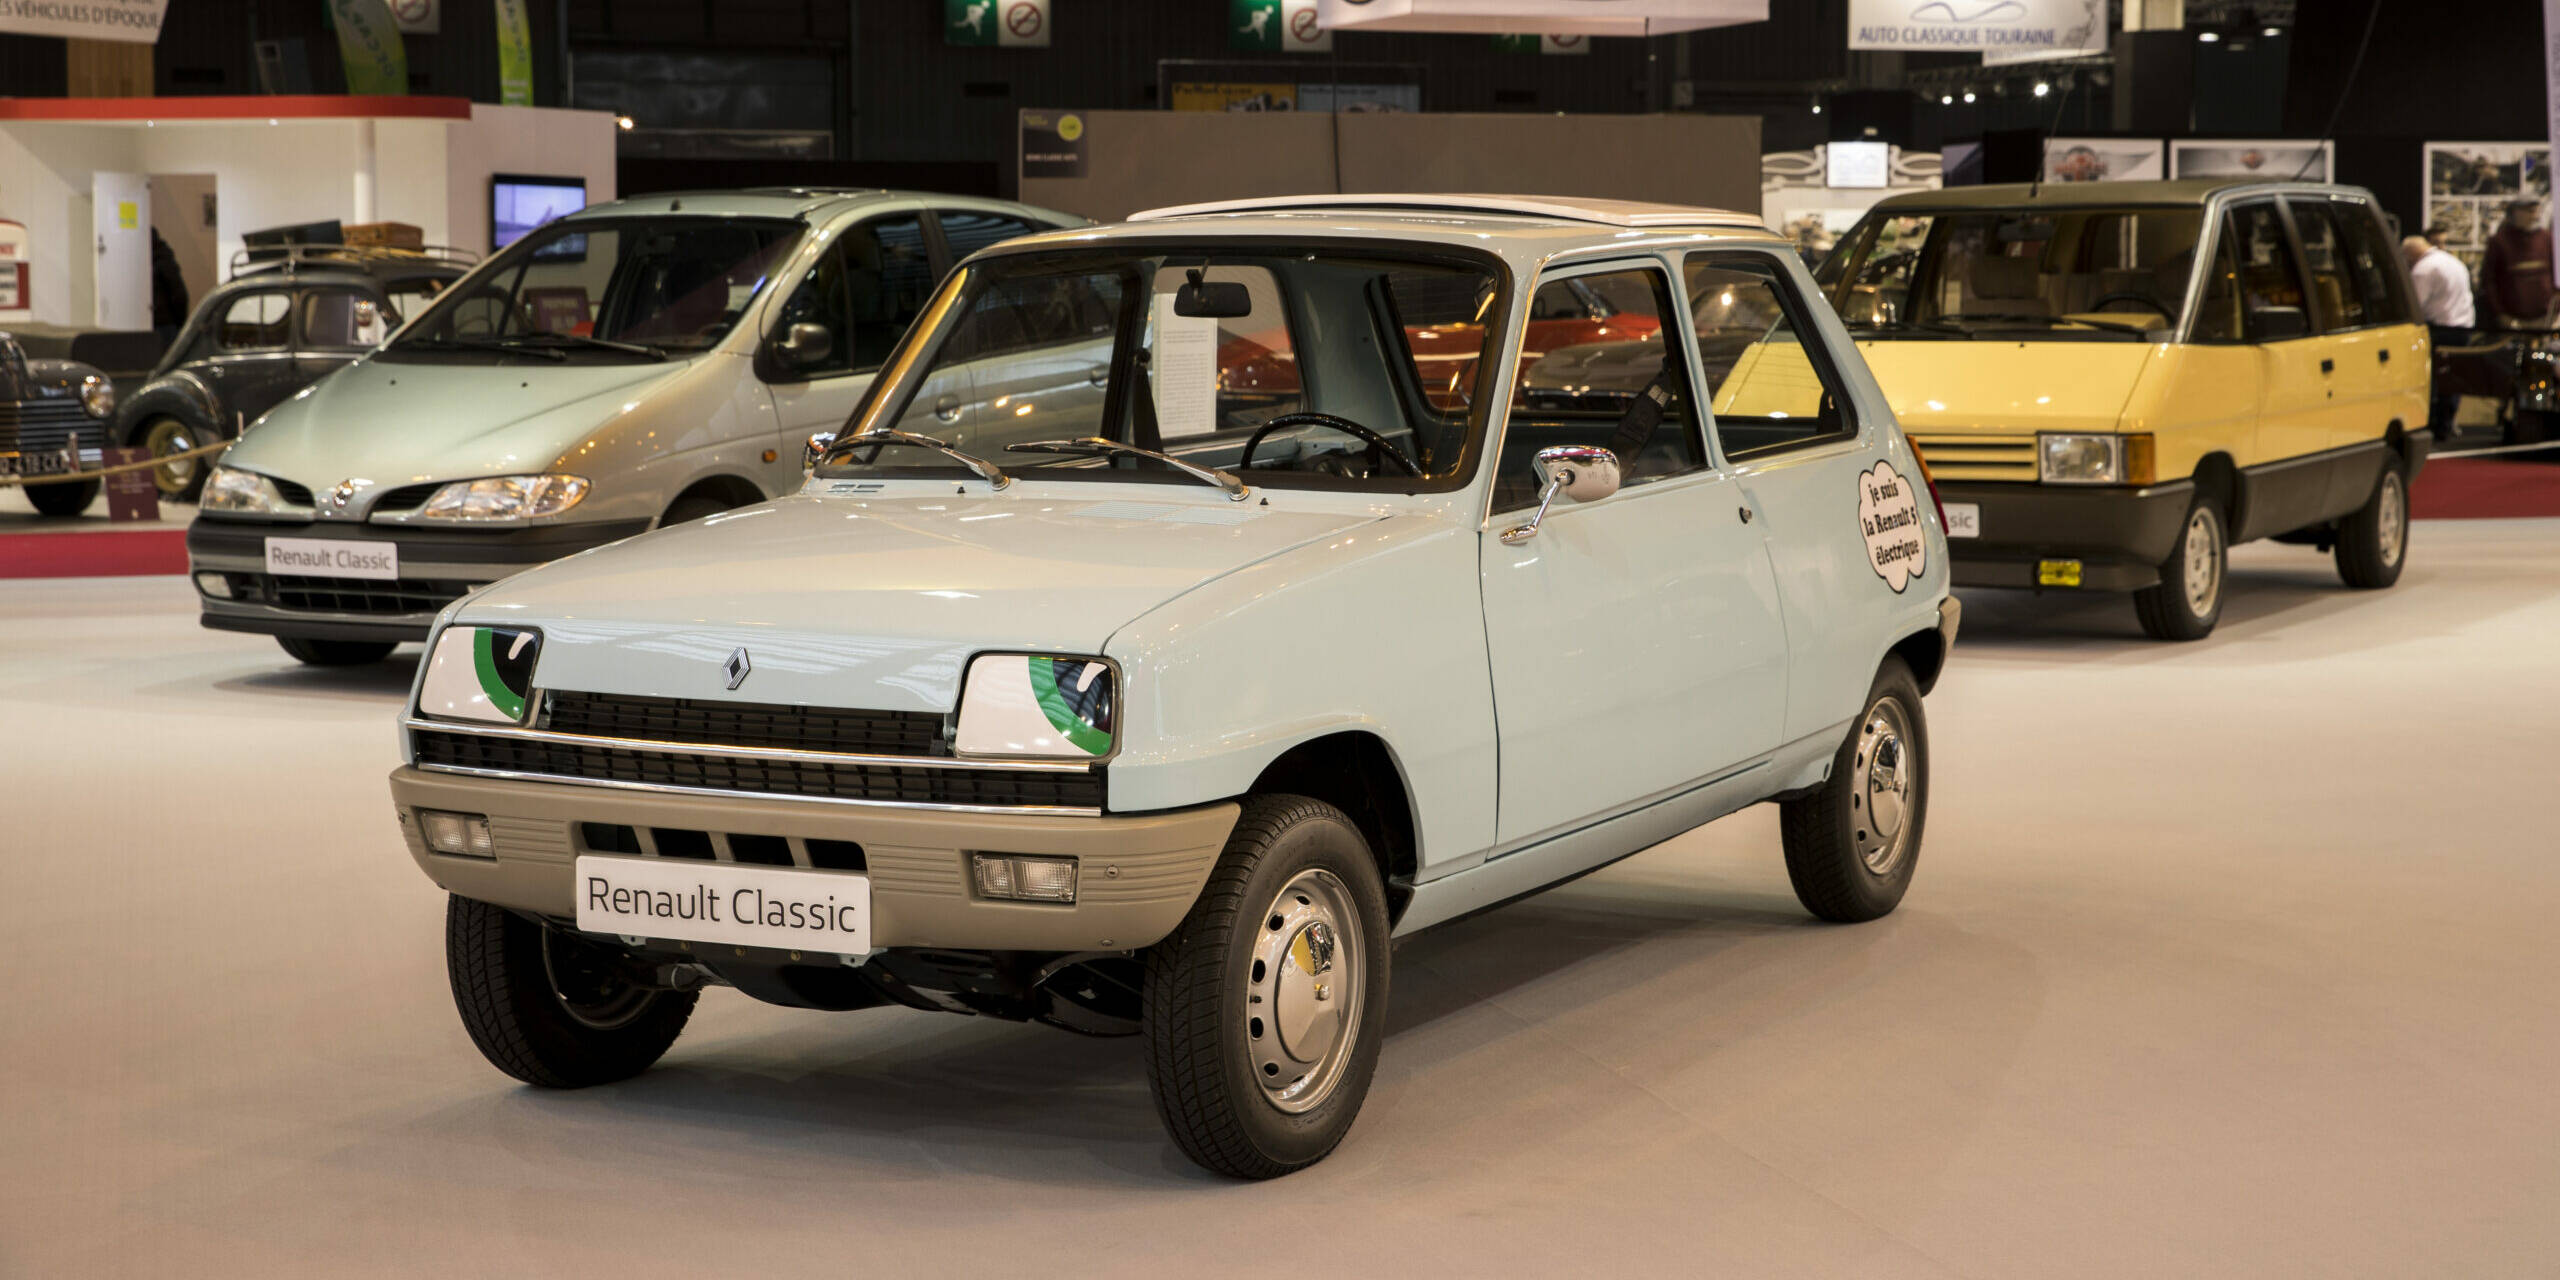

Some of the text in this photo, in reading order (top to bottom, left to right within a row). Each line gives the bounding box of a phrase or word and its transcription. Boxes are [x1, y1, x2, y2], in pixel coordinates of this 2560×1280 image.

[1859, 27, 2055, 45] AUTO CLASSIQUE TOURAINE
[1868, 478, 1898, 507] je suis
[1863, 506, 1917, 537] la Renault 5
[271, 546, 391, 570] Renault Classic
[1876, 539, 1919, 565] électrique
[588, 877, 855, 932] Renault Classic
